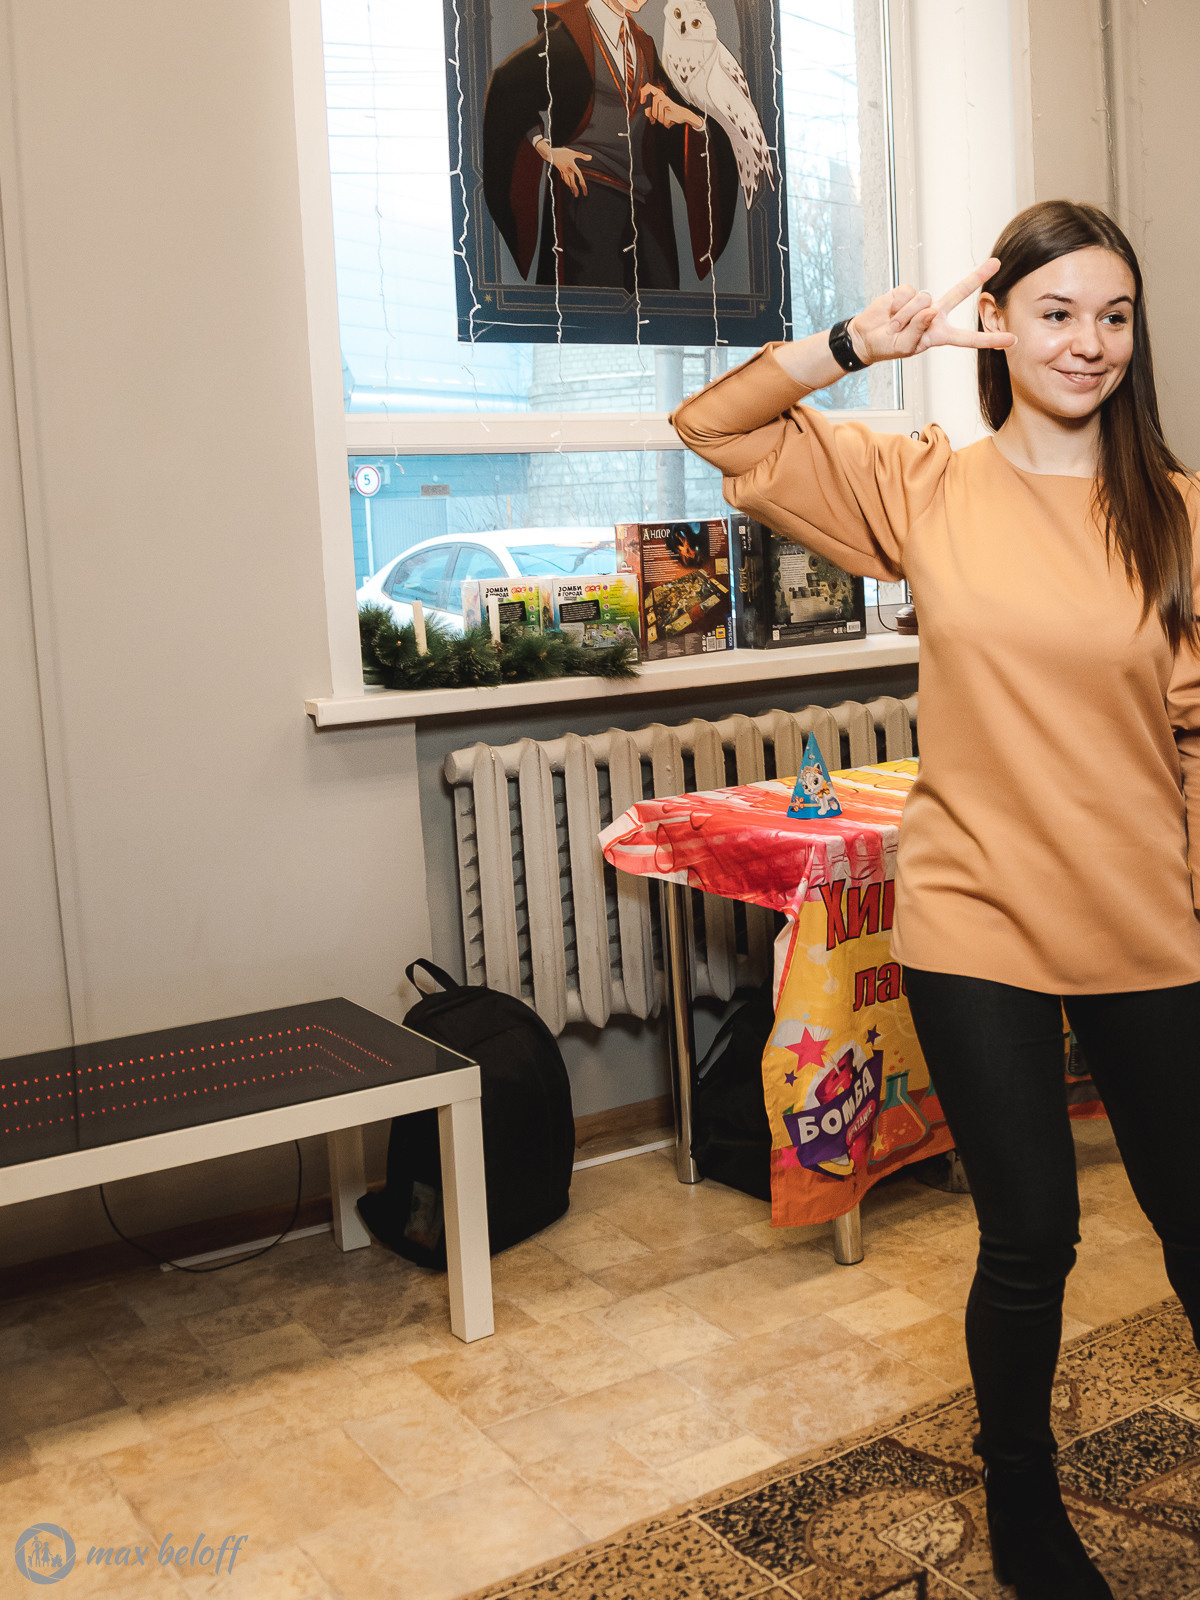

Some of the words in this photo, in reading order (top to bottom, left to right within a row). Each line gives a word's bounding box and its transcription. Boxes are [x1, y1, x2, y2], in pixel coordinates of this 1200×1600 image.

[364, 474, 371, 486] 5
[486, 586, 509, 594] ЗОМБИ
[558, 585, 582, 593] ЗОМБИ
[853, 962, 907, 1012] ла
[797, 1066, 875, 1144] БОМБА
